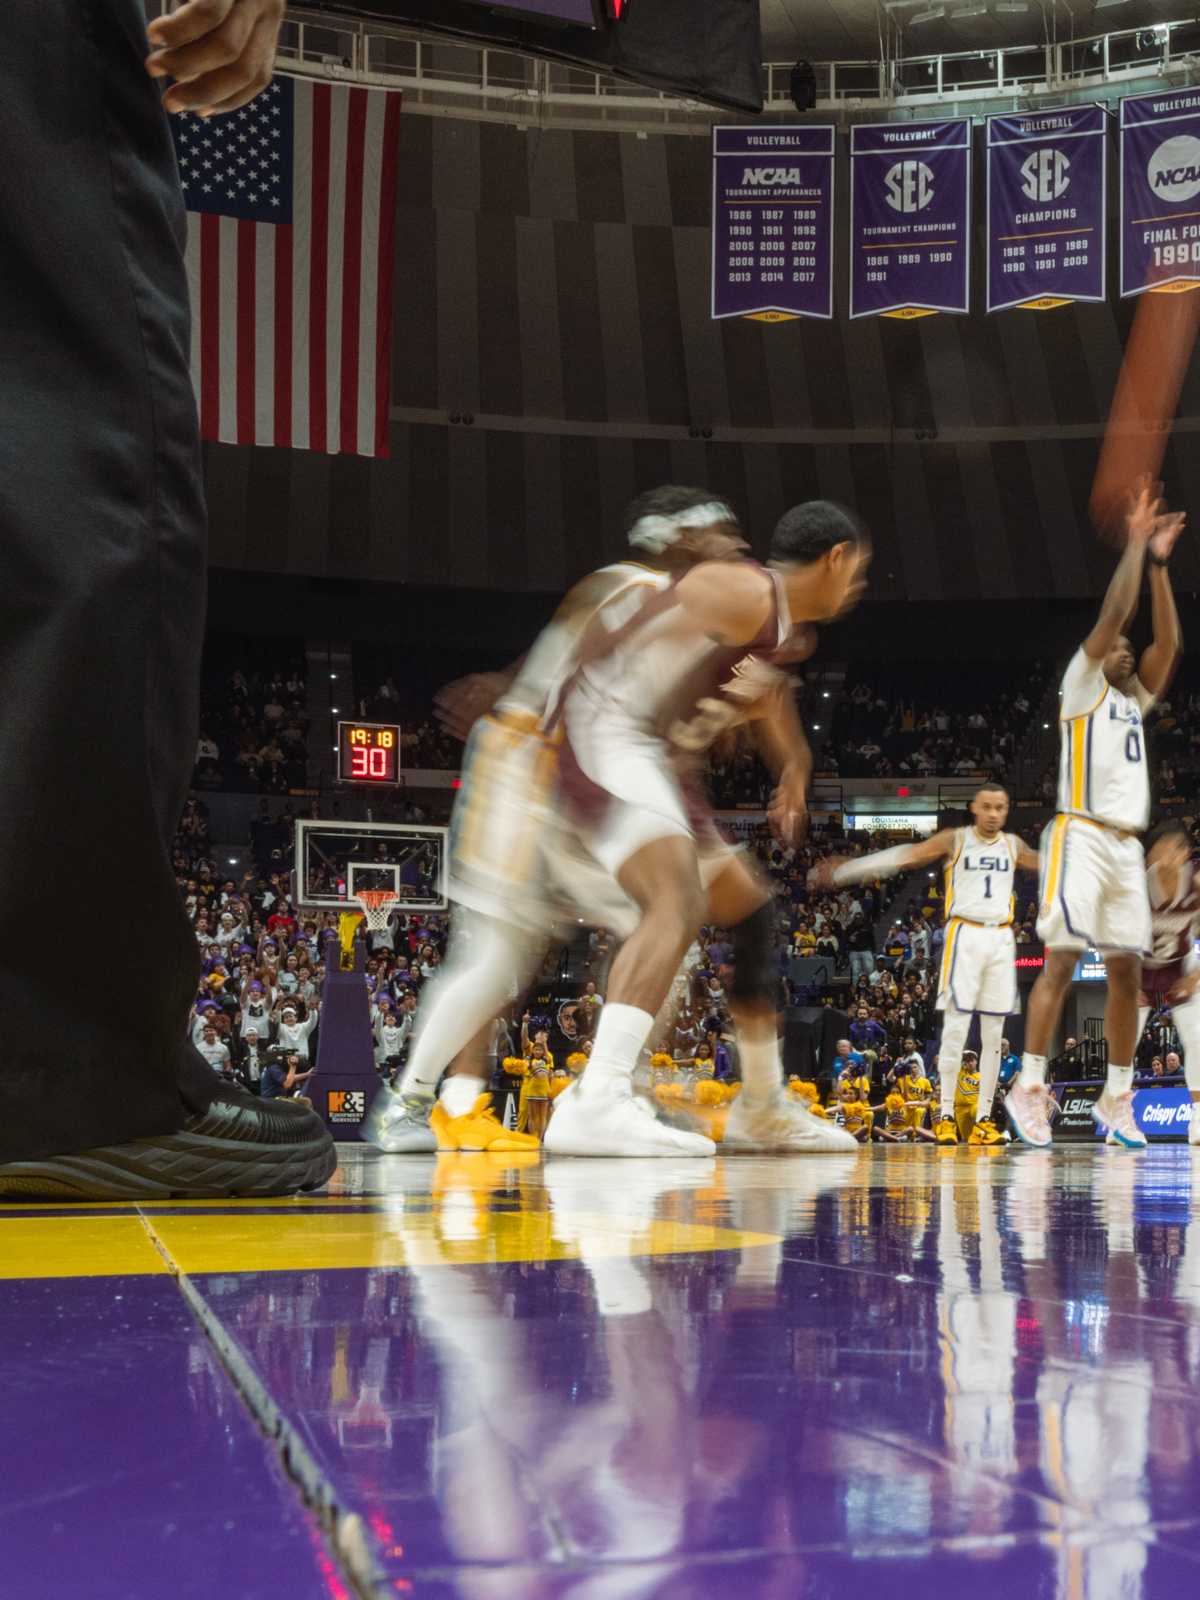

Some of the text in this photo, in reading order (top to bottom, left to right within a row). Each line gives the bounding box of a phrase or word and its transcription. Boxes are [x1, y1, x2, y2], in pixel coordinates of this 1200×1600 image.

[1020, 117, 1073, 132] VOLLEYBALL
[747, 136, 800, 145] VOLLEYBALL
[883, 130, 936, 142] VOLLEYBALL
[742, 168, 801, 185] NCAA
[1020, 149, 1070, 202] SEC
[773, 188, 822, 196] APPEARANCES
[884, 160, 935, 213] SEC
[762, 210, 784, 220] 1987
[793, 210, 816, 220] 1989
[1016, 208, 1077, 224] CHAMPIONS
[729, 226, 816, 236] 1990 1991 1992
[863, 223, 957, 235] TOURNAMENT CHAMPIONS
[1144, 226, 1178, 244] FINAL
[729, 241, 816, 251] 2005 2006 2007
[729, 257, 816, 266] 2008 2009 2010
[1035, 259, 1056, 270] 1991
[1063, 255, 1088, 267] 2009
[729, 272, 815, 282] 2013 2014 2017
[351, 729, 393, 748] 19:18
[1125, 730, 1141, 762] 0
[352, 746, 386, 776] 30
[964, 856, 1009, 872] LSU
[983, 874, 993, 898] 1
[1012, 957, 1043, 967] nMobil
[329, 1092, 365, 1112] H&E
[1143, 1104, 1177, 1125] Crispy
